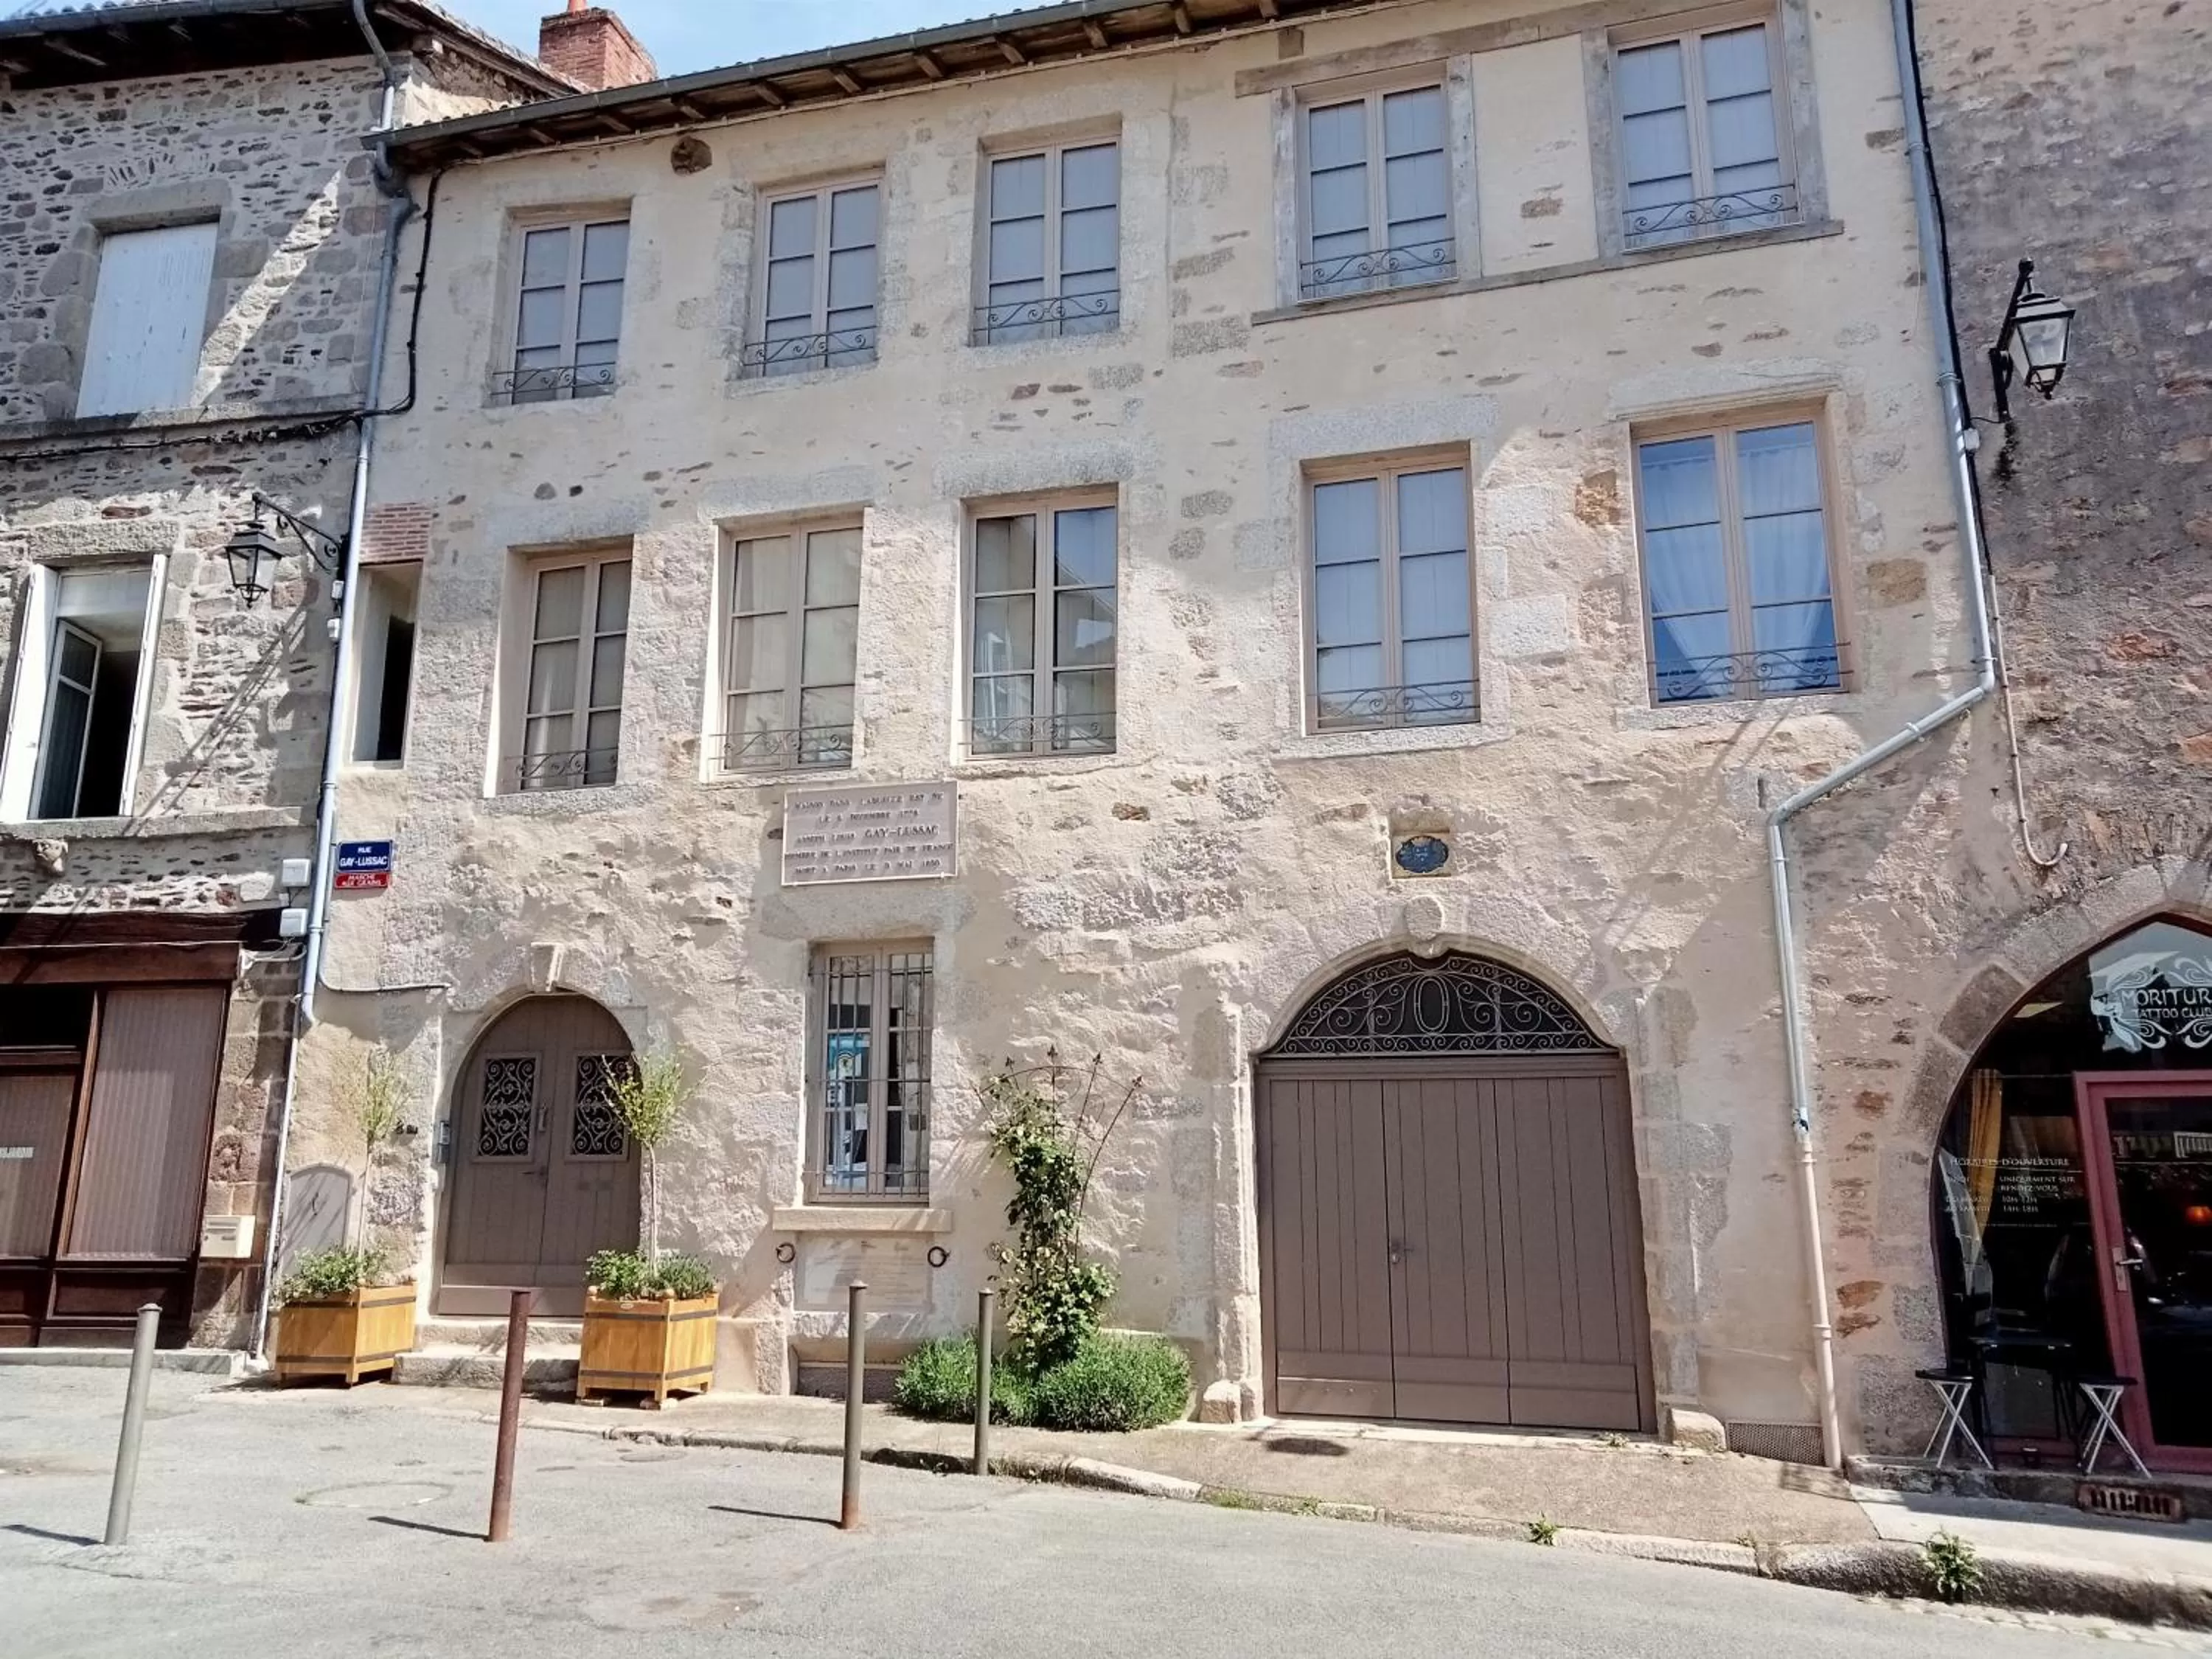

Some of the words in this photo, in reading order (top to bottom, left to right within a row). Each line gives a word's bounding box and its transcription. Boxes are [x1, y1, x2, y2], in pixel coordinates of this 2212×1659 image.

[864, 824, 939, 838] GAY-LUSSAC
[340, 855, 387, 867] GAY-LUSSAC
[2131, 1008, 2179, 1018] TATTOO
[2182, 1006, 2212, 1018] CLUB
